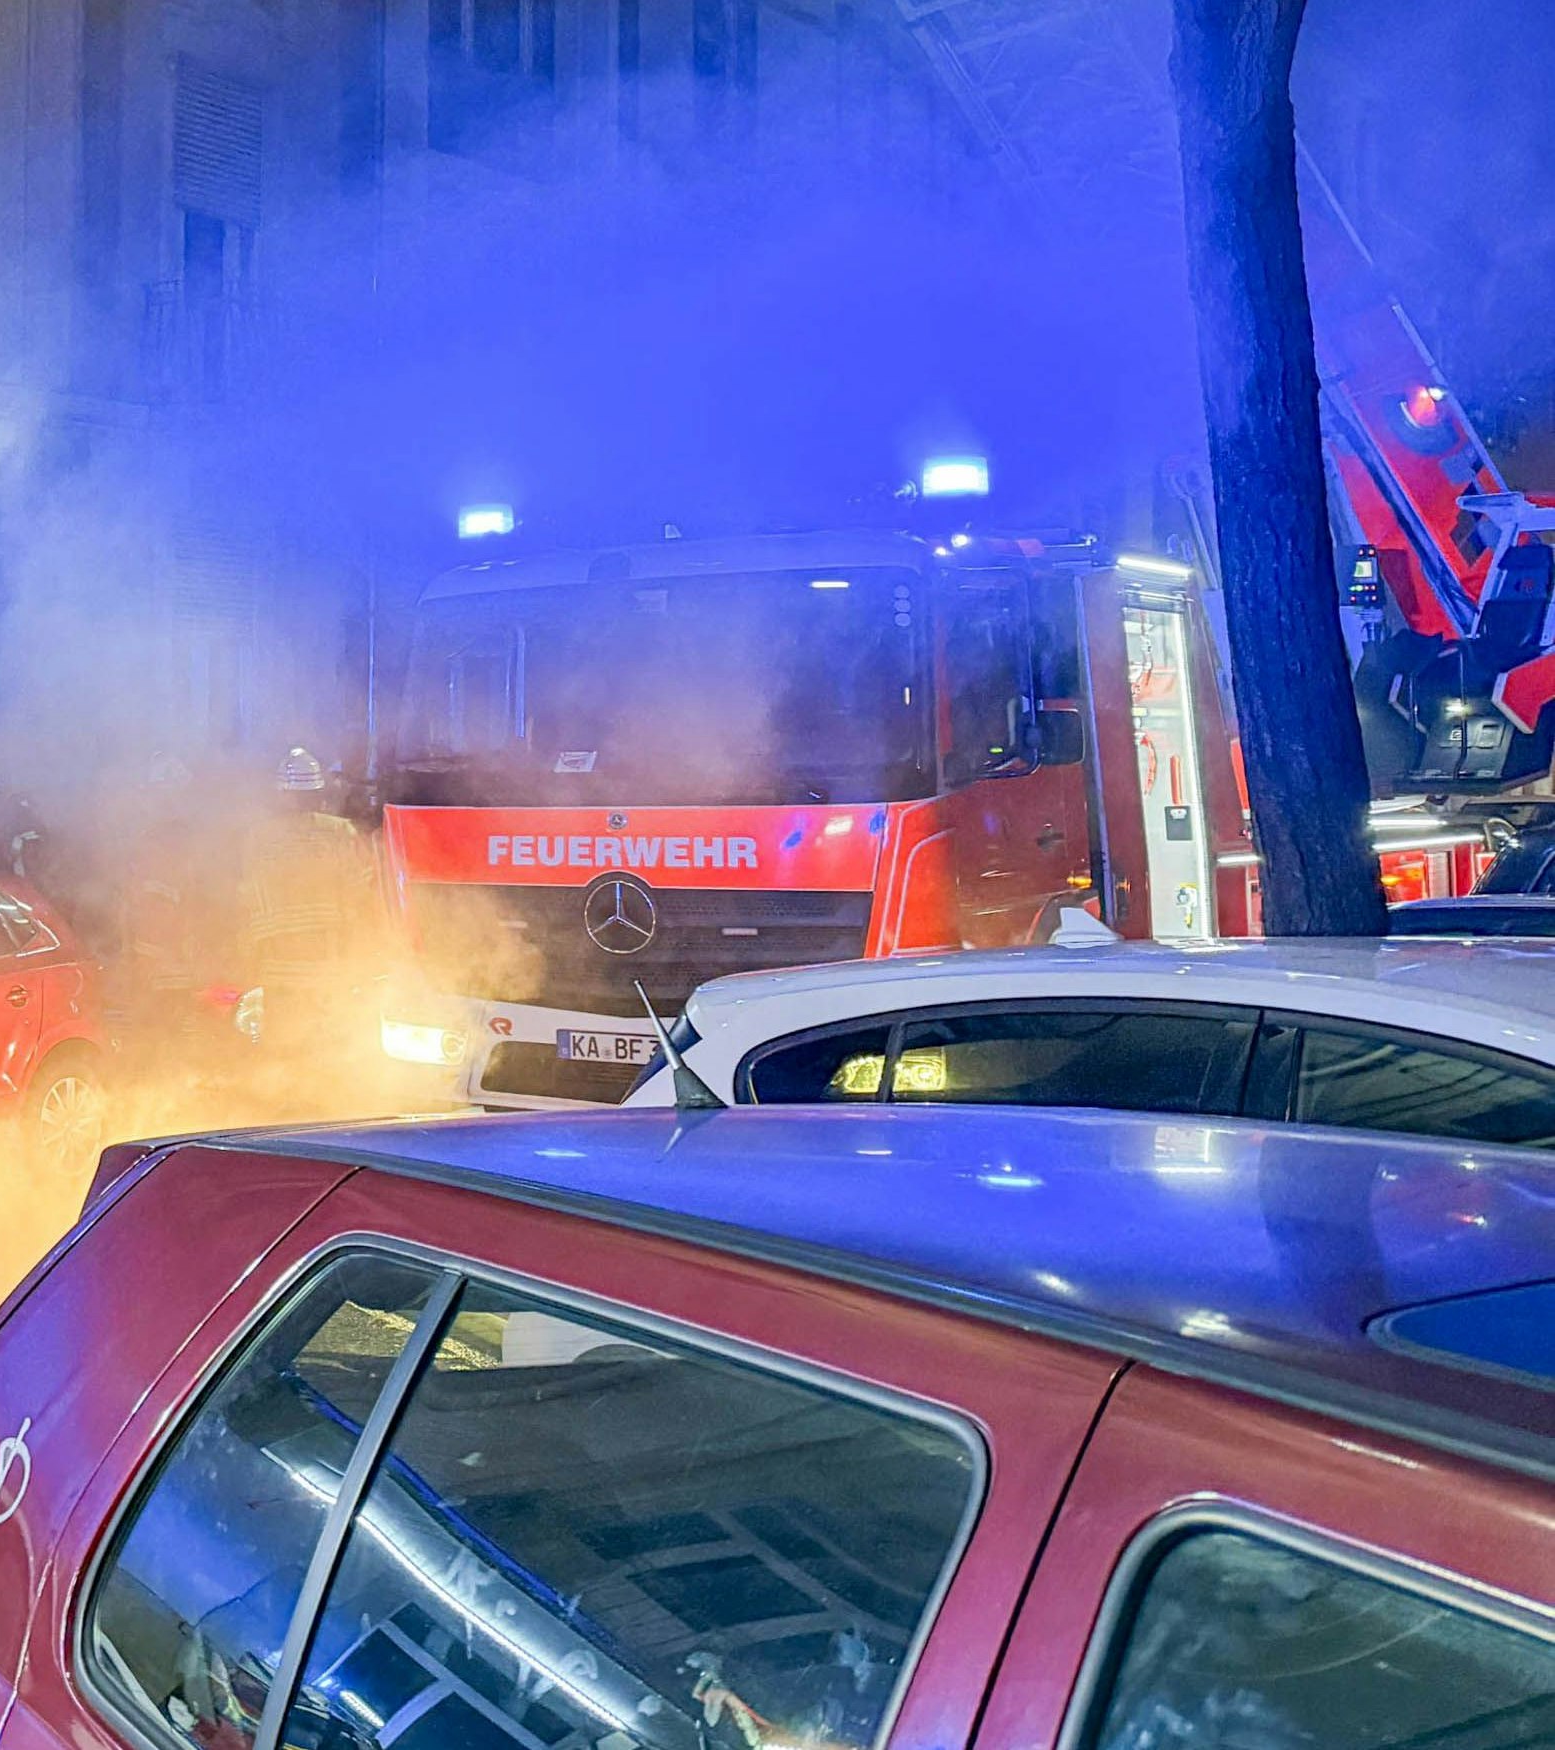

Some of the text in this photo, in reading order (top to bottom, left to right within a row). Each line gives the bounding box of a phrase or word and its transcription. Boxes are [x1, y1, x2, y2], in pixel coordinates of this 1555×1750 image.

[488, 835, 758, 869] FEUERWEHR
[571, 1035, 600, 1059] KA
[614, 1037, 642, 1060] BF
